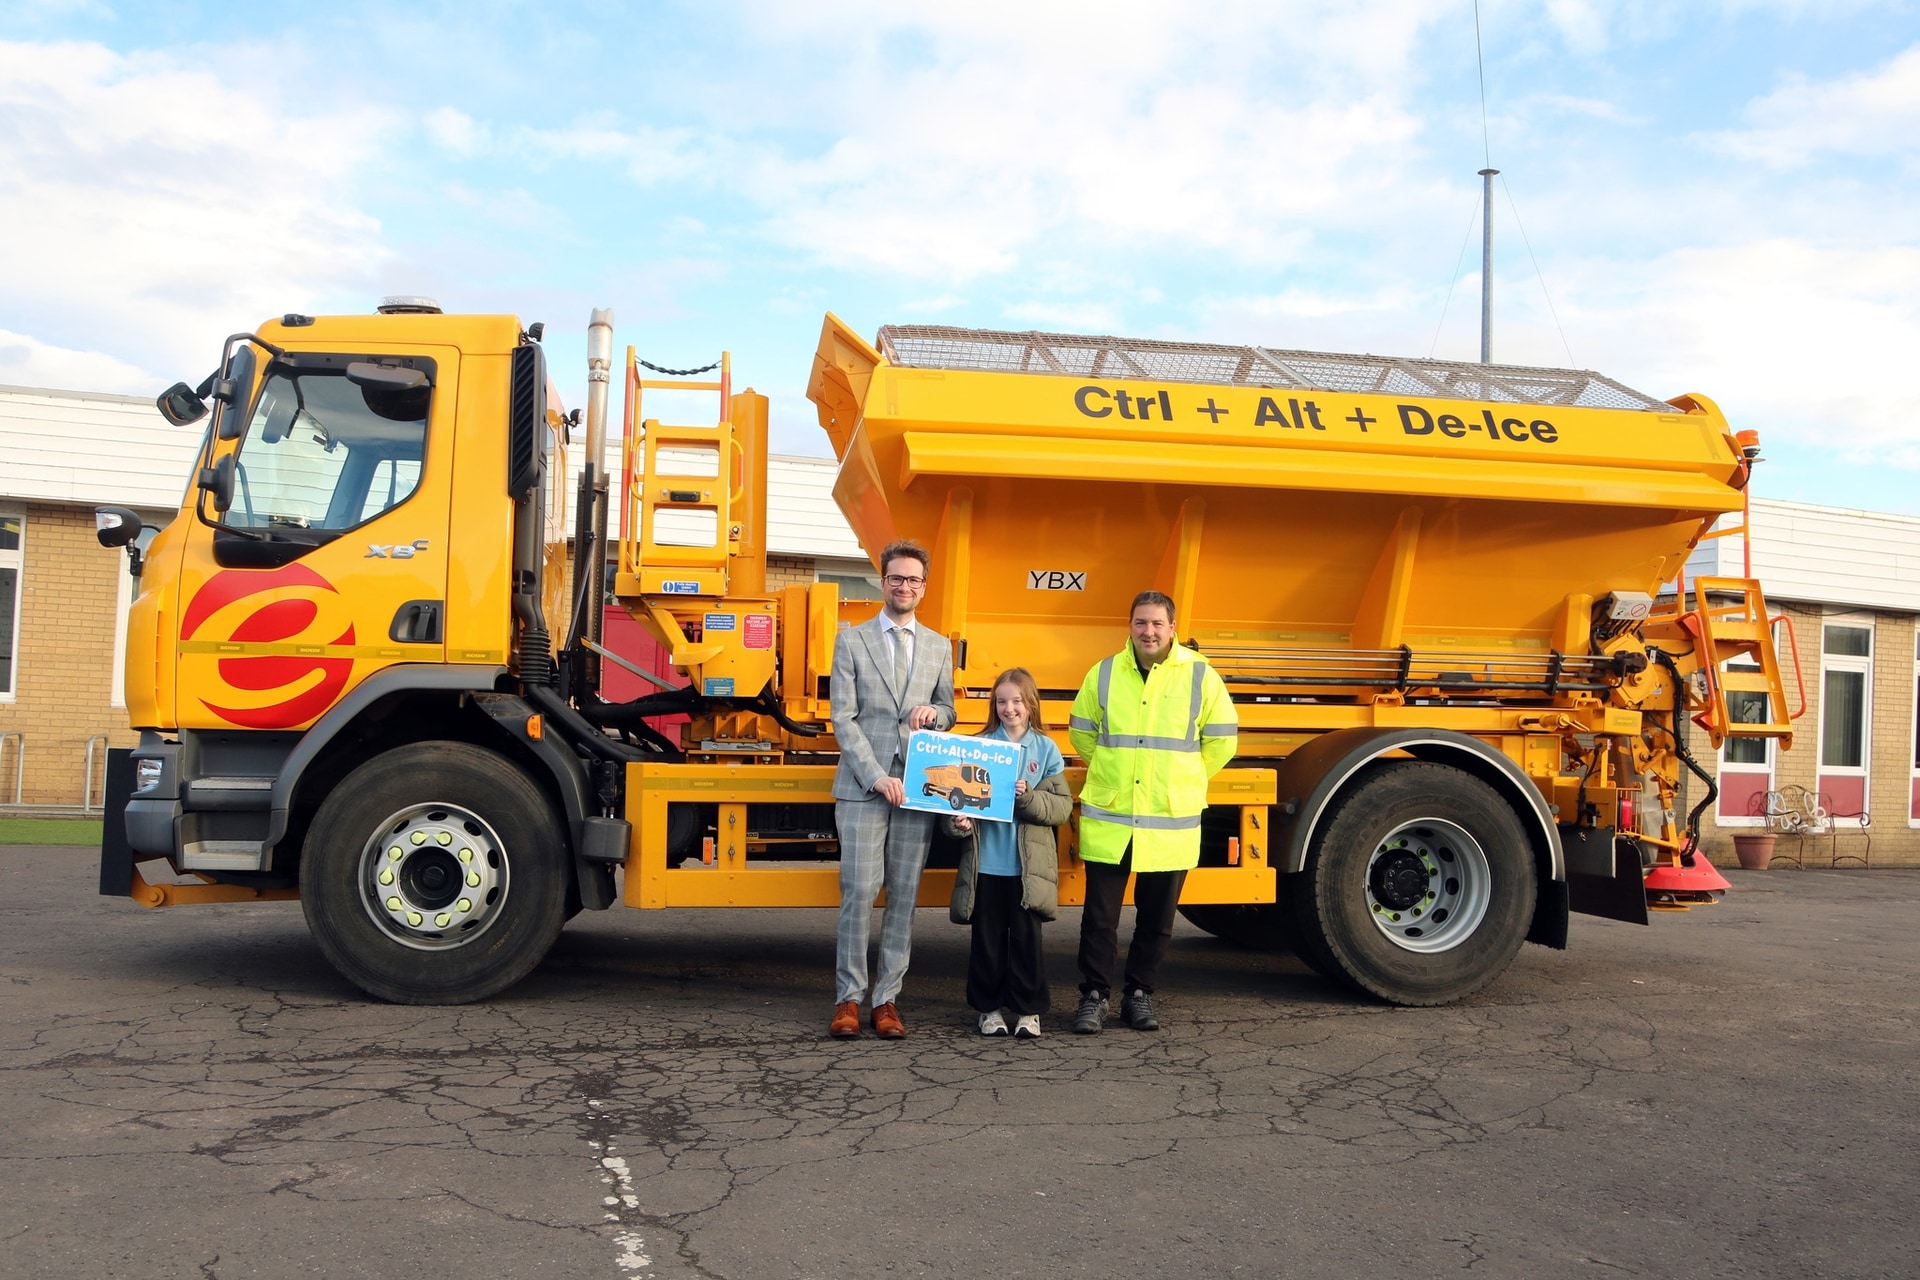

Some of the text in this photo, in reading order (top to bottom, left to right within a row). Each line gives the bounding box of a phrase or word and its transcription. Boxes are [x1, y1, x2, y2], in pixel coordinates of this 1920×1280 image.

[1075, 387, 1559, 443] Ctrl + Alt + De-Ice
[1030, 570, 1085, 591] YBX
